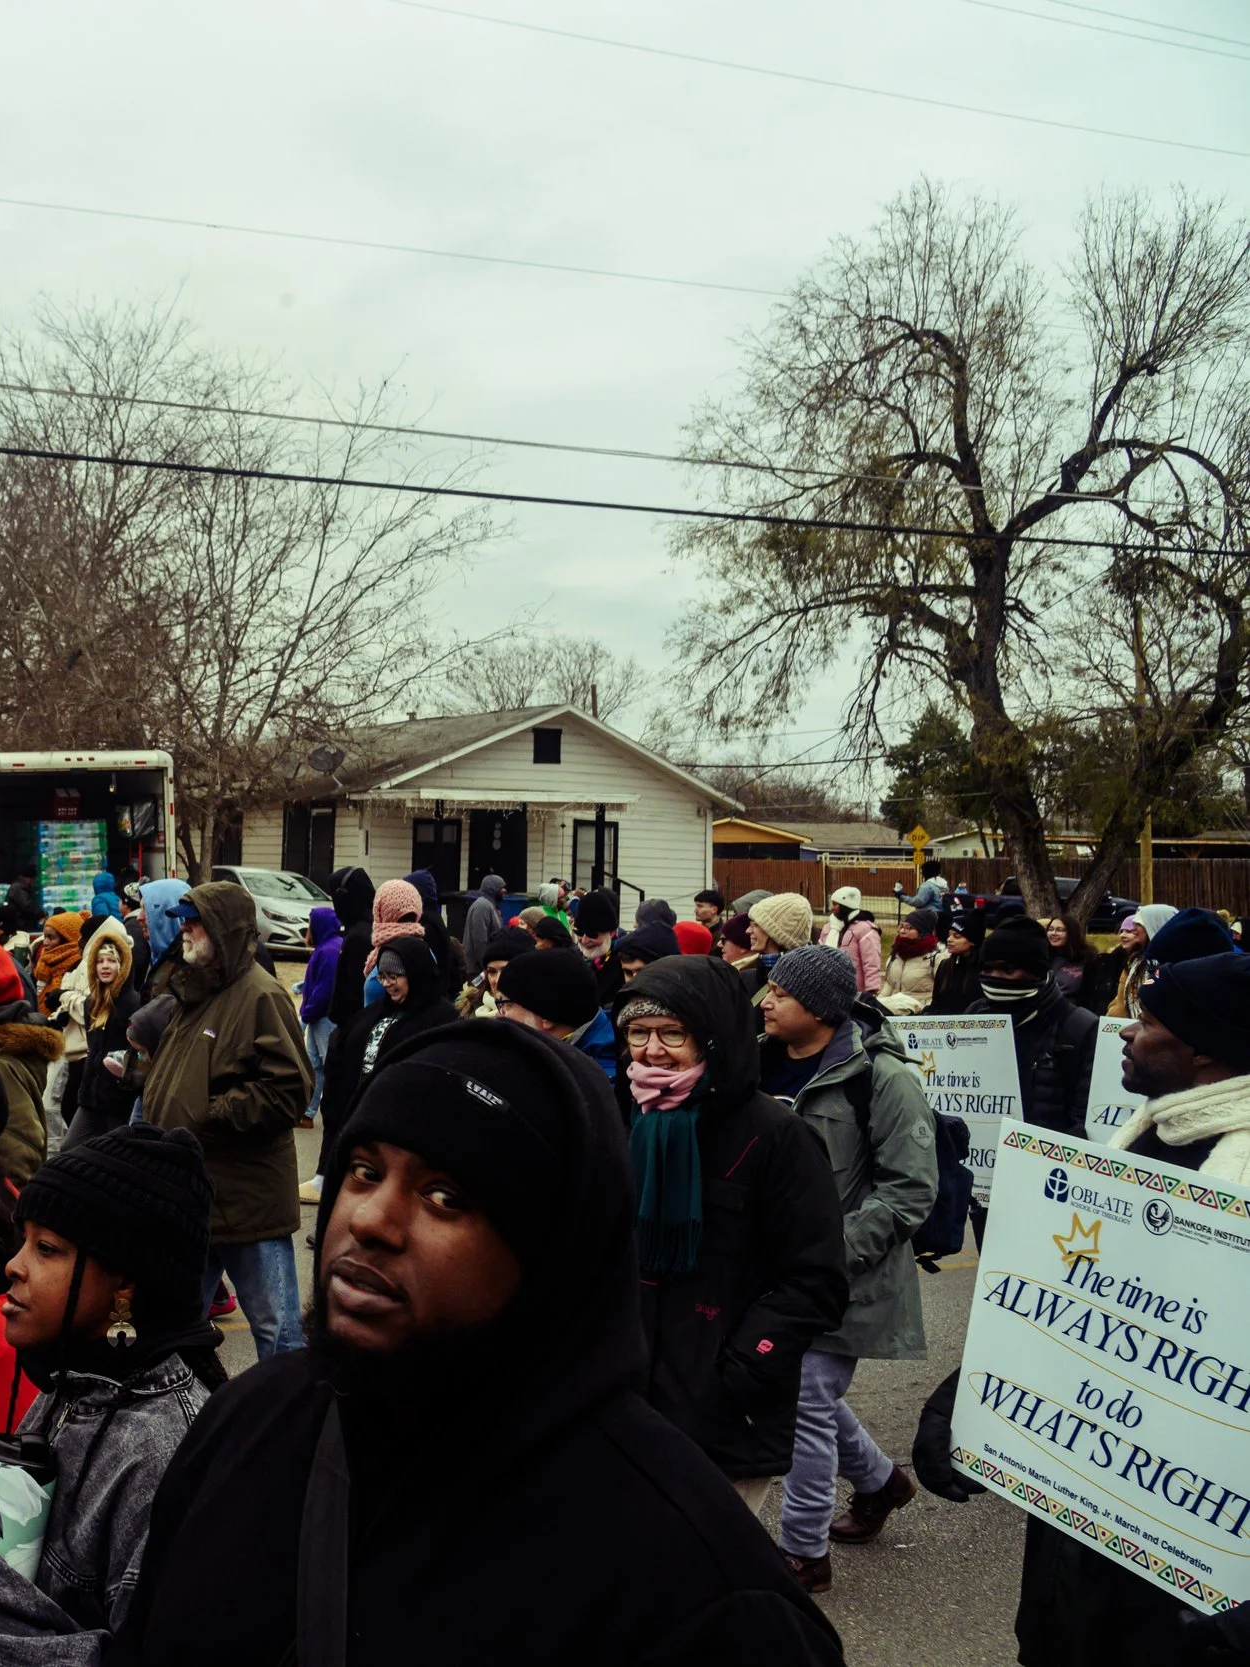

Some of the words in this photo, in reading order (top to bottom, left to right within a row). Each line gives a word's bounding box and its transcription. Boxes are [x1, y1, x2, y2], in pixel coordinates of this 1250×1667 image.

[912, 834, 926, 842] DIP
[924, 1069, 945, 1088] The
[947, 1070, 971, 1089] time
[972, 1071, 981, 1089] is
[965, 1094, 1016, 1115] RIGHT
[1070, 1200, 1091, 1213] SCHOOL
[1092, 1207, 1101, 1215] OF
[1101, 1210, 1131, 1226] THEOLOGY
[1071, 1185, 1134, 1218] OBLATE
[1173, 1215, 1212, 1235] SANKOFA
[1061, 1250, 1115, 1298] The
[1116, 1276, 1180, 1323] time
[1181, 1298, 1208, 1334] is
[983, 1275, 1147, 1362] ALWAYS
[1075, 1379, 1104, 1410] to
[1105, 1389, 1143, 1428] do
[980, 1372, 1122, 1469] WHAT'S
[1116, 1443, 1250, 1539] RIGHT
[984, 1443, 997, 1457] San
[998, 1452, 1027, 1473] Antonio
[1028, 1467, 1052, 1487] Martin
[1053, 1481, 1078, 1501] Luther
[1079, 1495, 1100, 1515] King,
[1102, 1509, 1113, 1521] Jr.
[1114, 1514, 1141, 1535] March
[1142, 1531, 1160, 1546] and
[1161, 1540, 1213, 1575] Celebration
